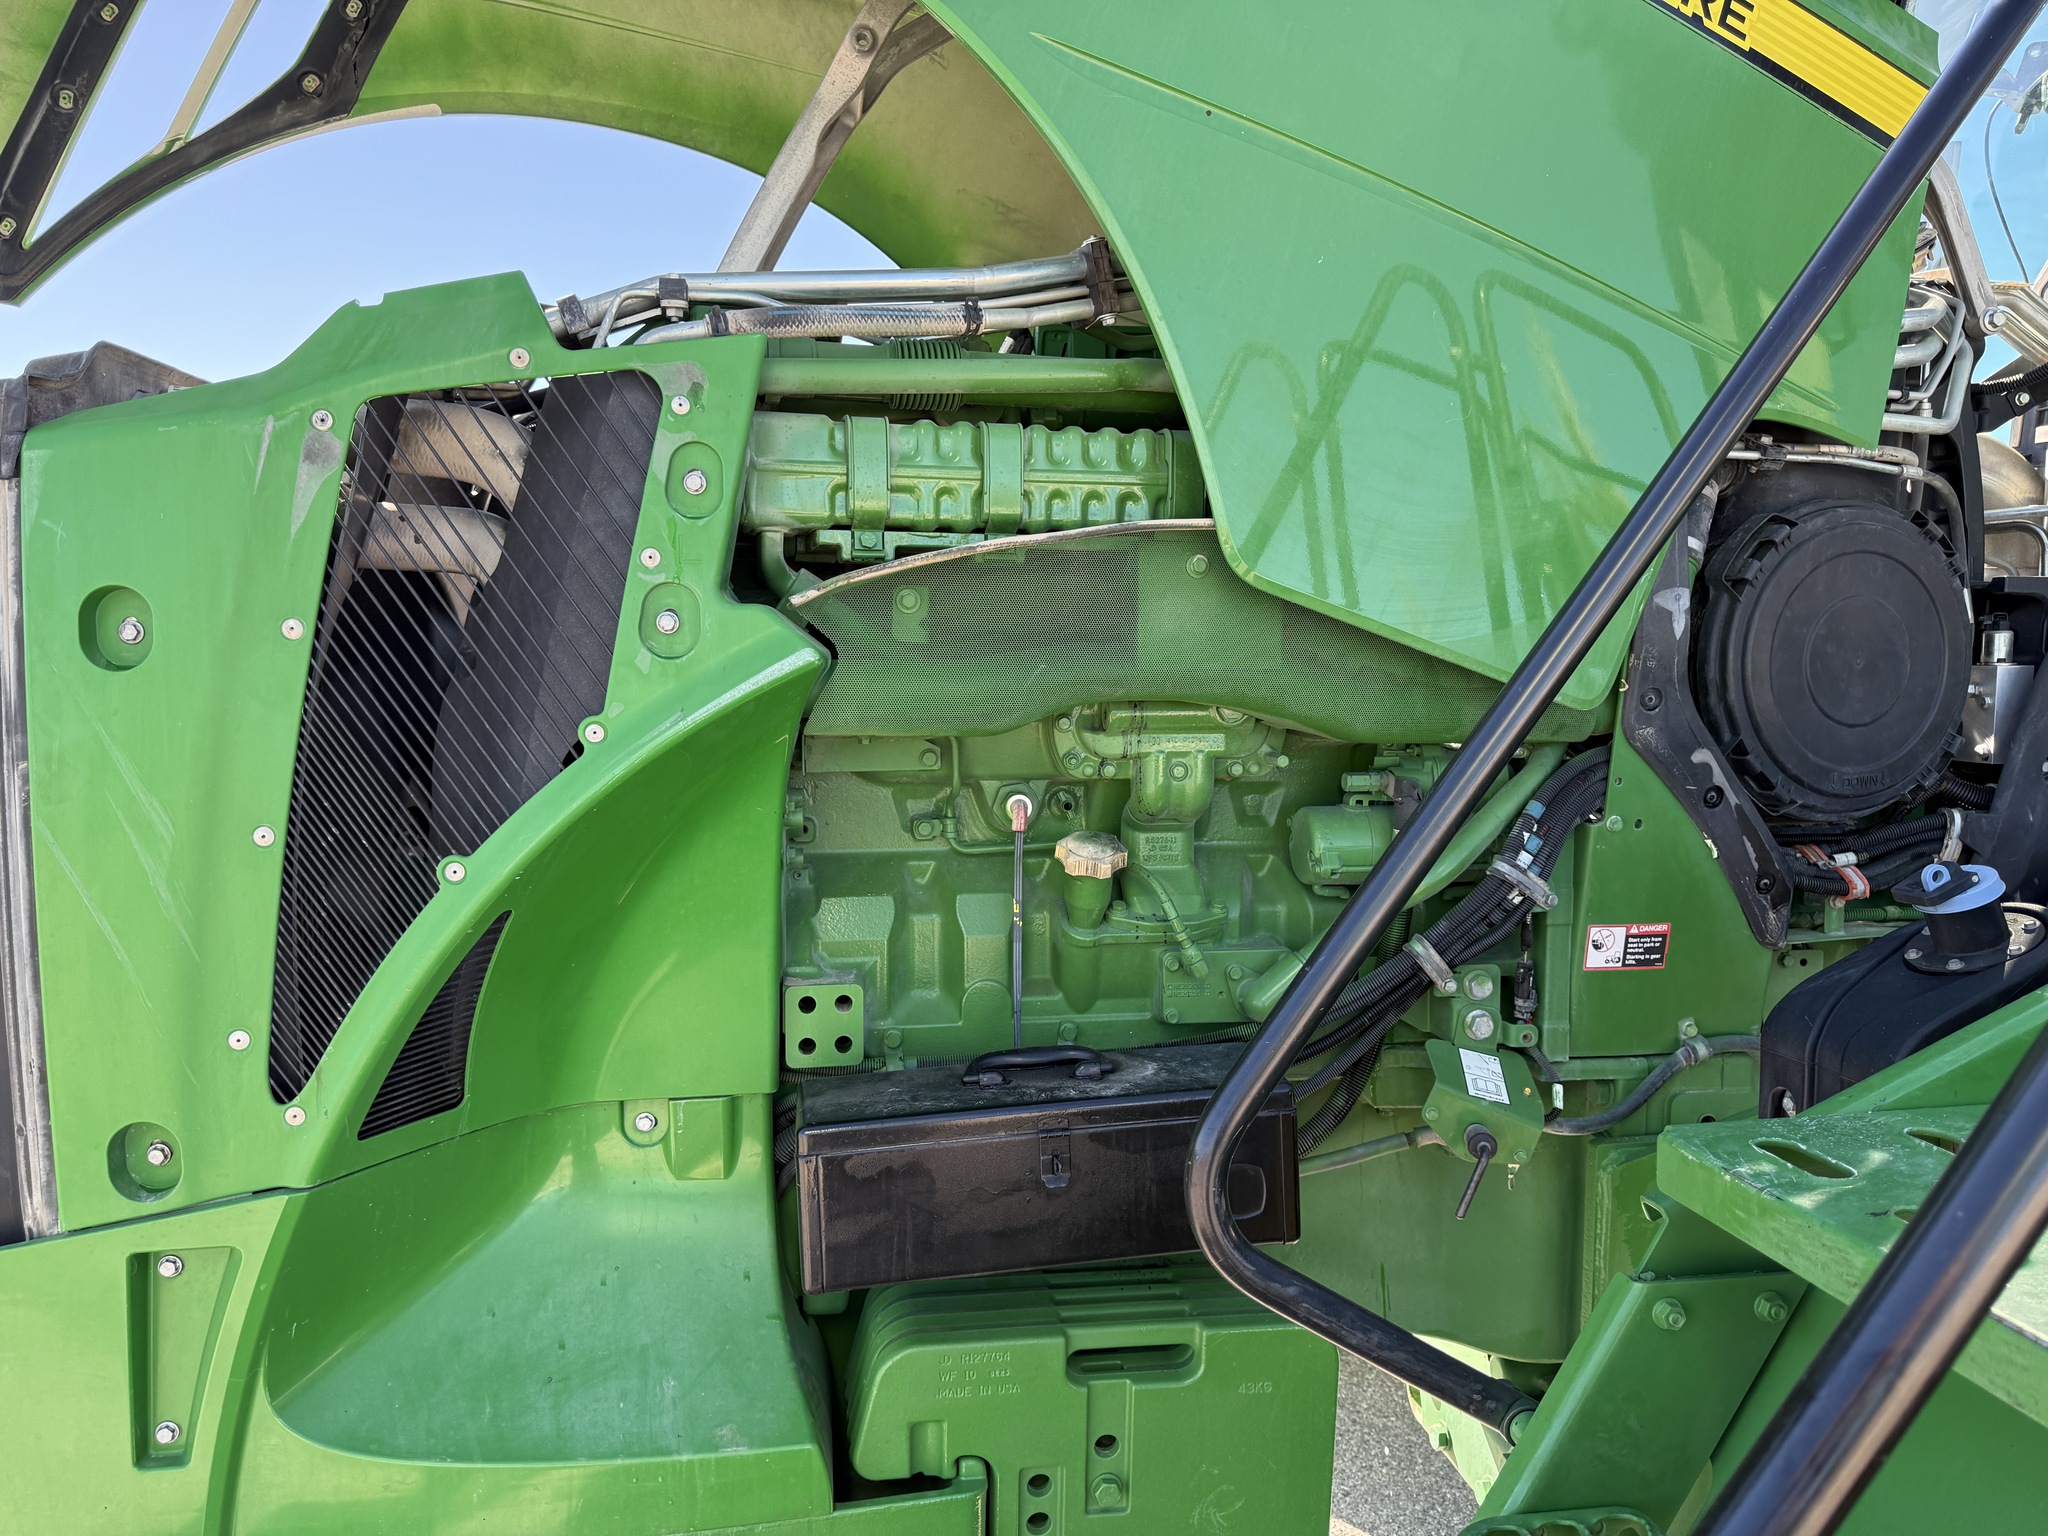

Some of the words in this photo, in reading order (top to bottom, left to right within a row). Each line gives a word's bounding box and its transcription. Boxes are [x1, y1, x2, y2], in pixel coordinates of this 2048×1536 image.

[1842, 774, 1879, 789] DOWN
[938, 1370, 957, 1382] WF
[936, 1386, 972, 1399] MADE
[978, 1384, 992, 1396] IN
[997, 1383, 1021, 1396] USA
